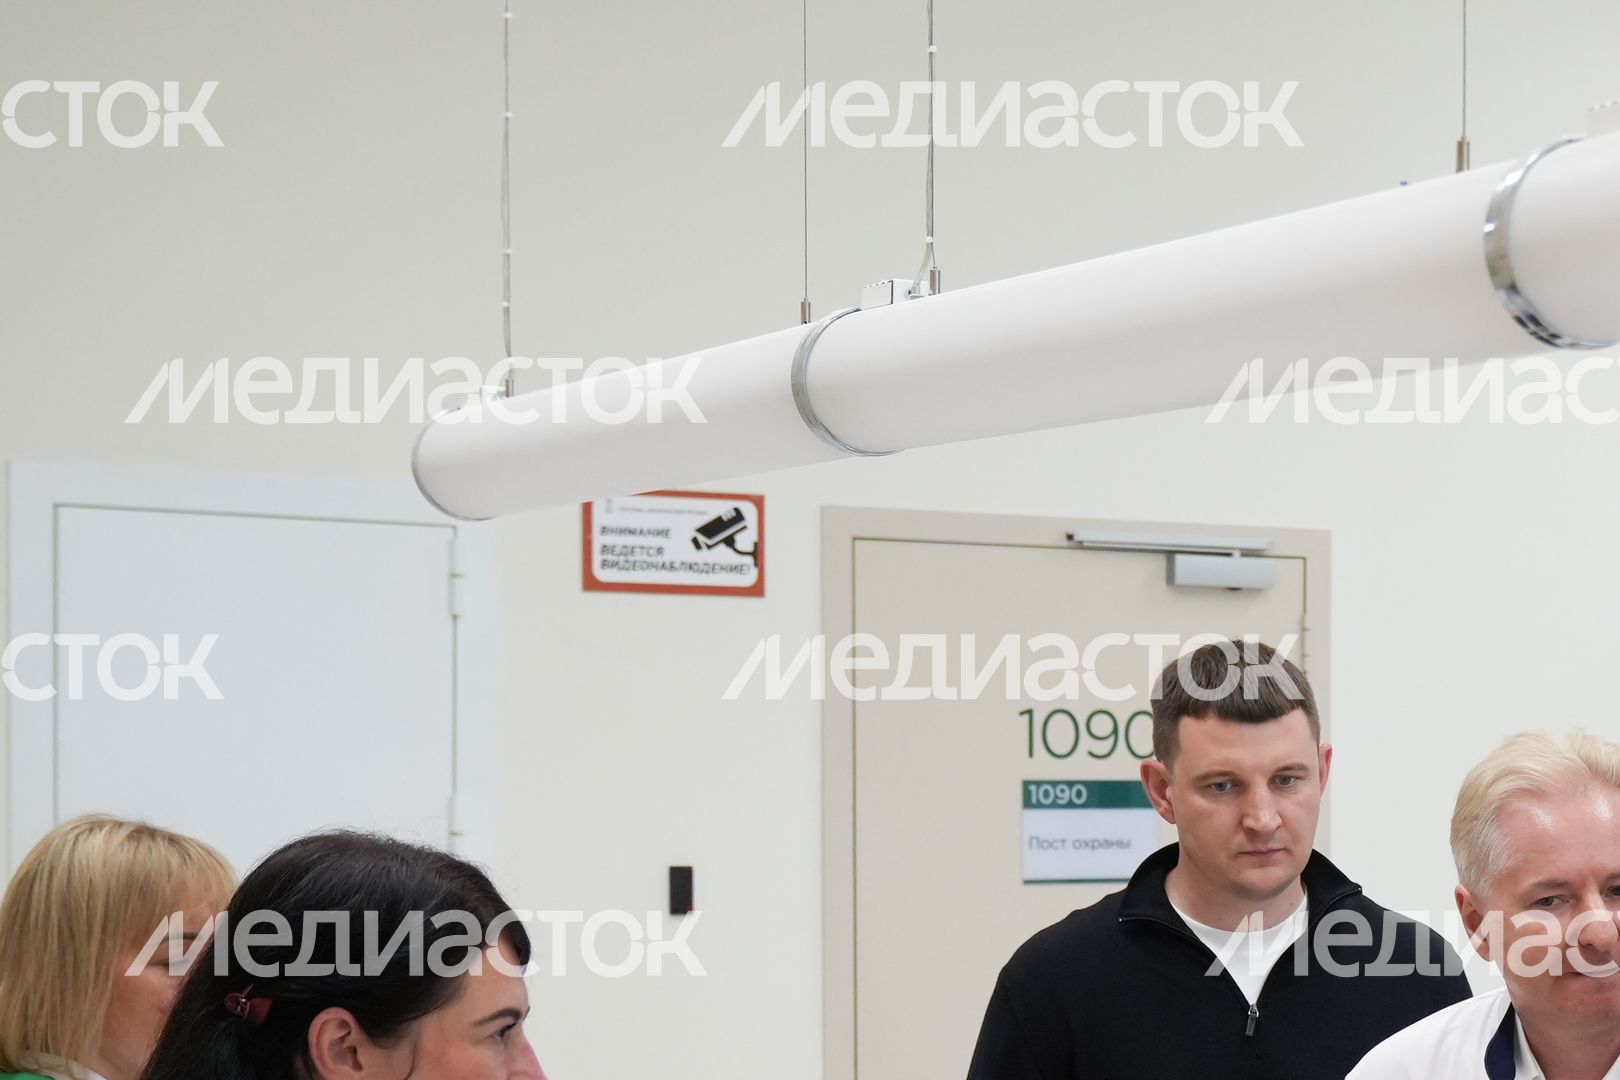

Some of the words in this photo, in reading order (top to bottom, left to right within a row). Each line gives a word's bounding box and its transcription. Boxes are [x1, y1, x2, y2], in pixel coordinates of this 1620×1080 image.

[600, 526, 672, 539] ВНИМАНИЕ
[600, 544, 664, 558] ВЕДЕТСЯ
[1019, 708, 1154, 760] 1090
[1028, 784, 1087, 805] 1090
[1028, 836, 1067, 850] Пост
[1071, 838, 1132, 853] охраны
